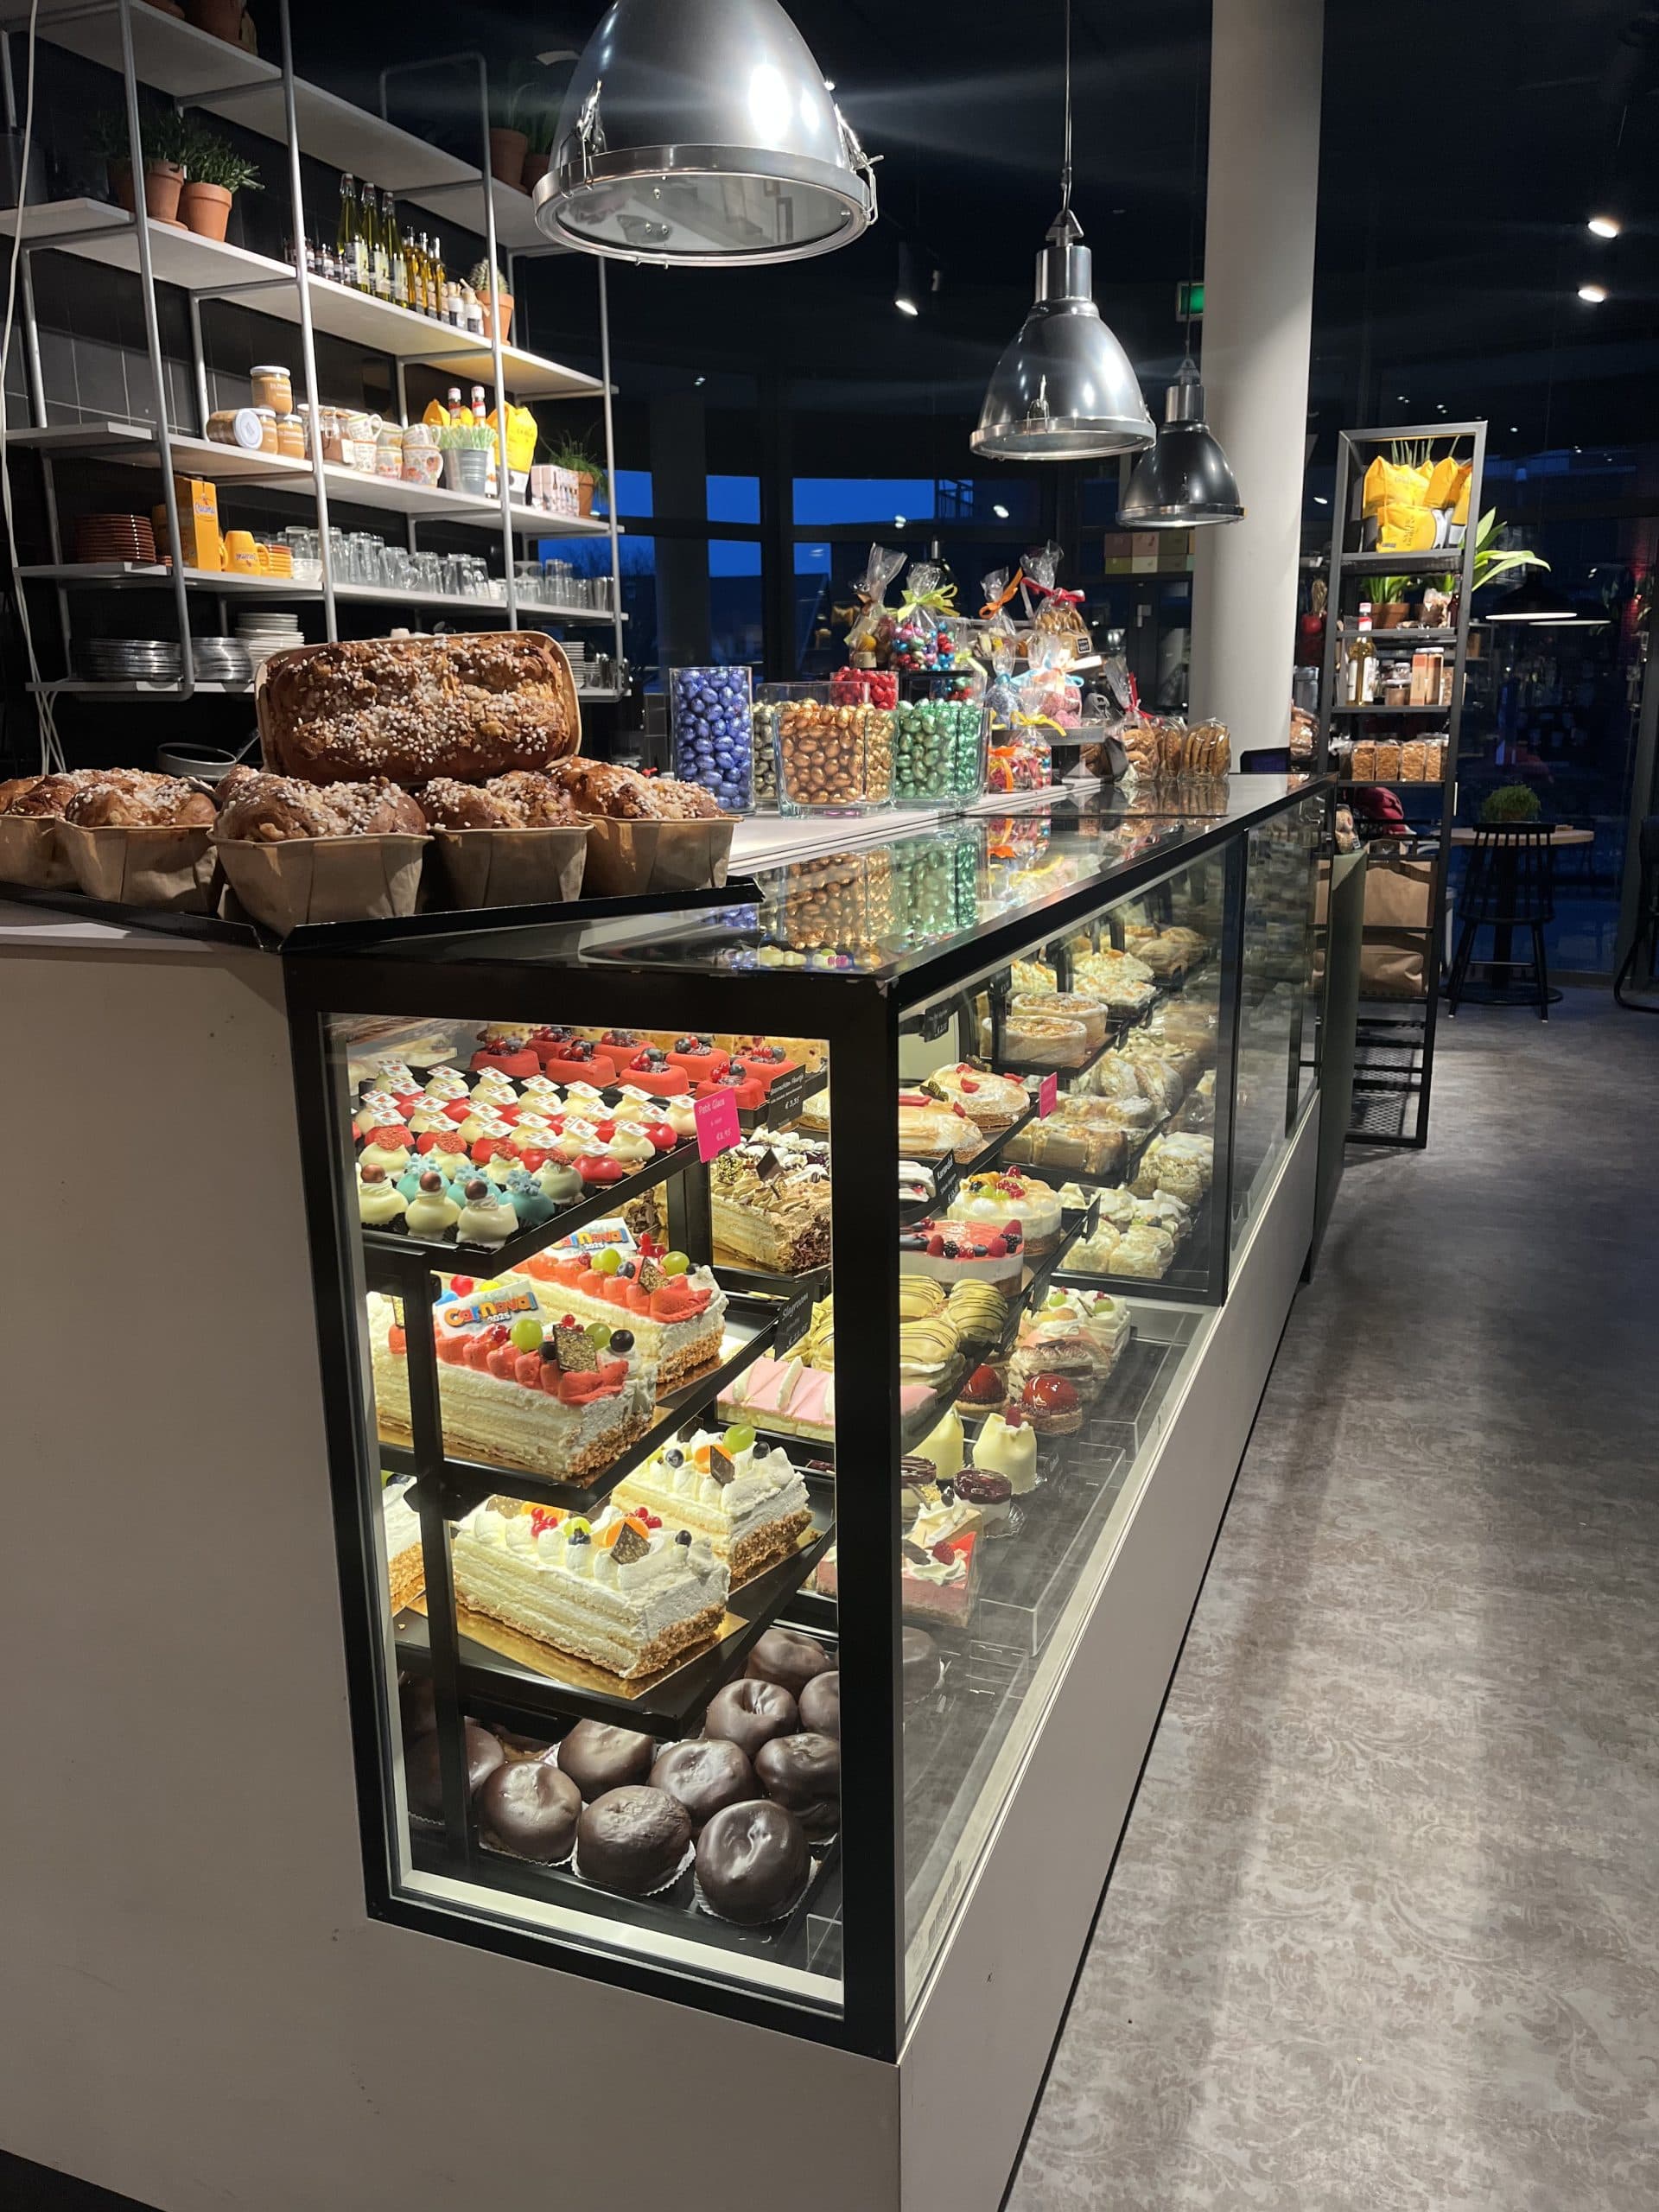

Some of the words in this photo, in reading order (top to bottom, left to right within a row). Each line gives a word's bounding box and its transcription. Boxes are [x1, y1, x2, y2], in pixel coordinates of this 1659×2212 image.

[583, 1241, 605, 1250] 2025
[444, 1291, 538, 1328] Carnaval
[486, 1312, 512, 1325] 2025
